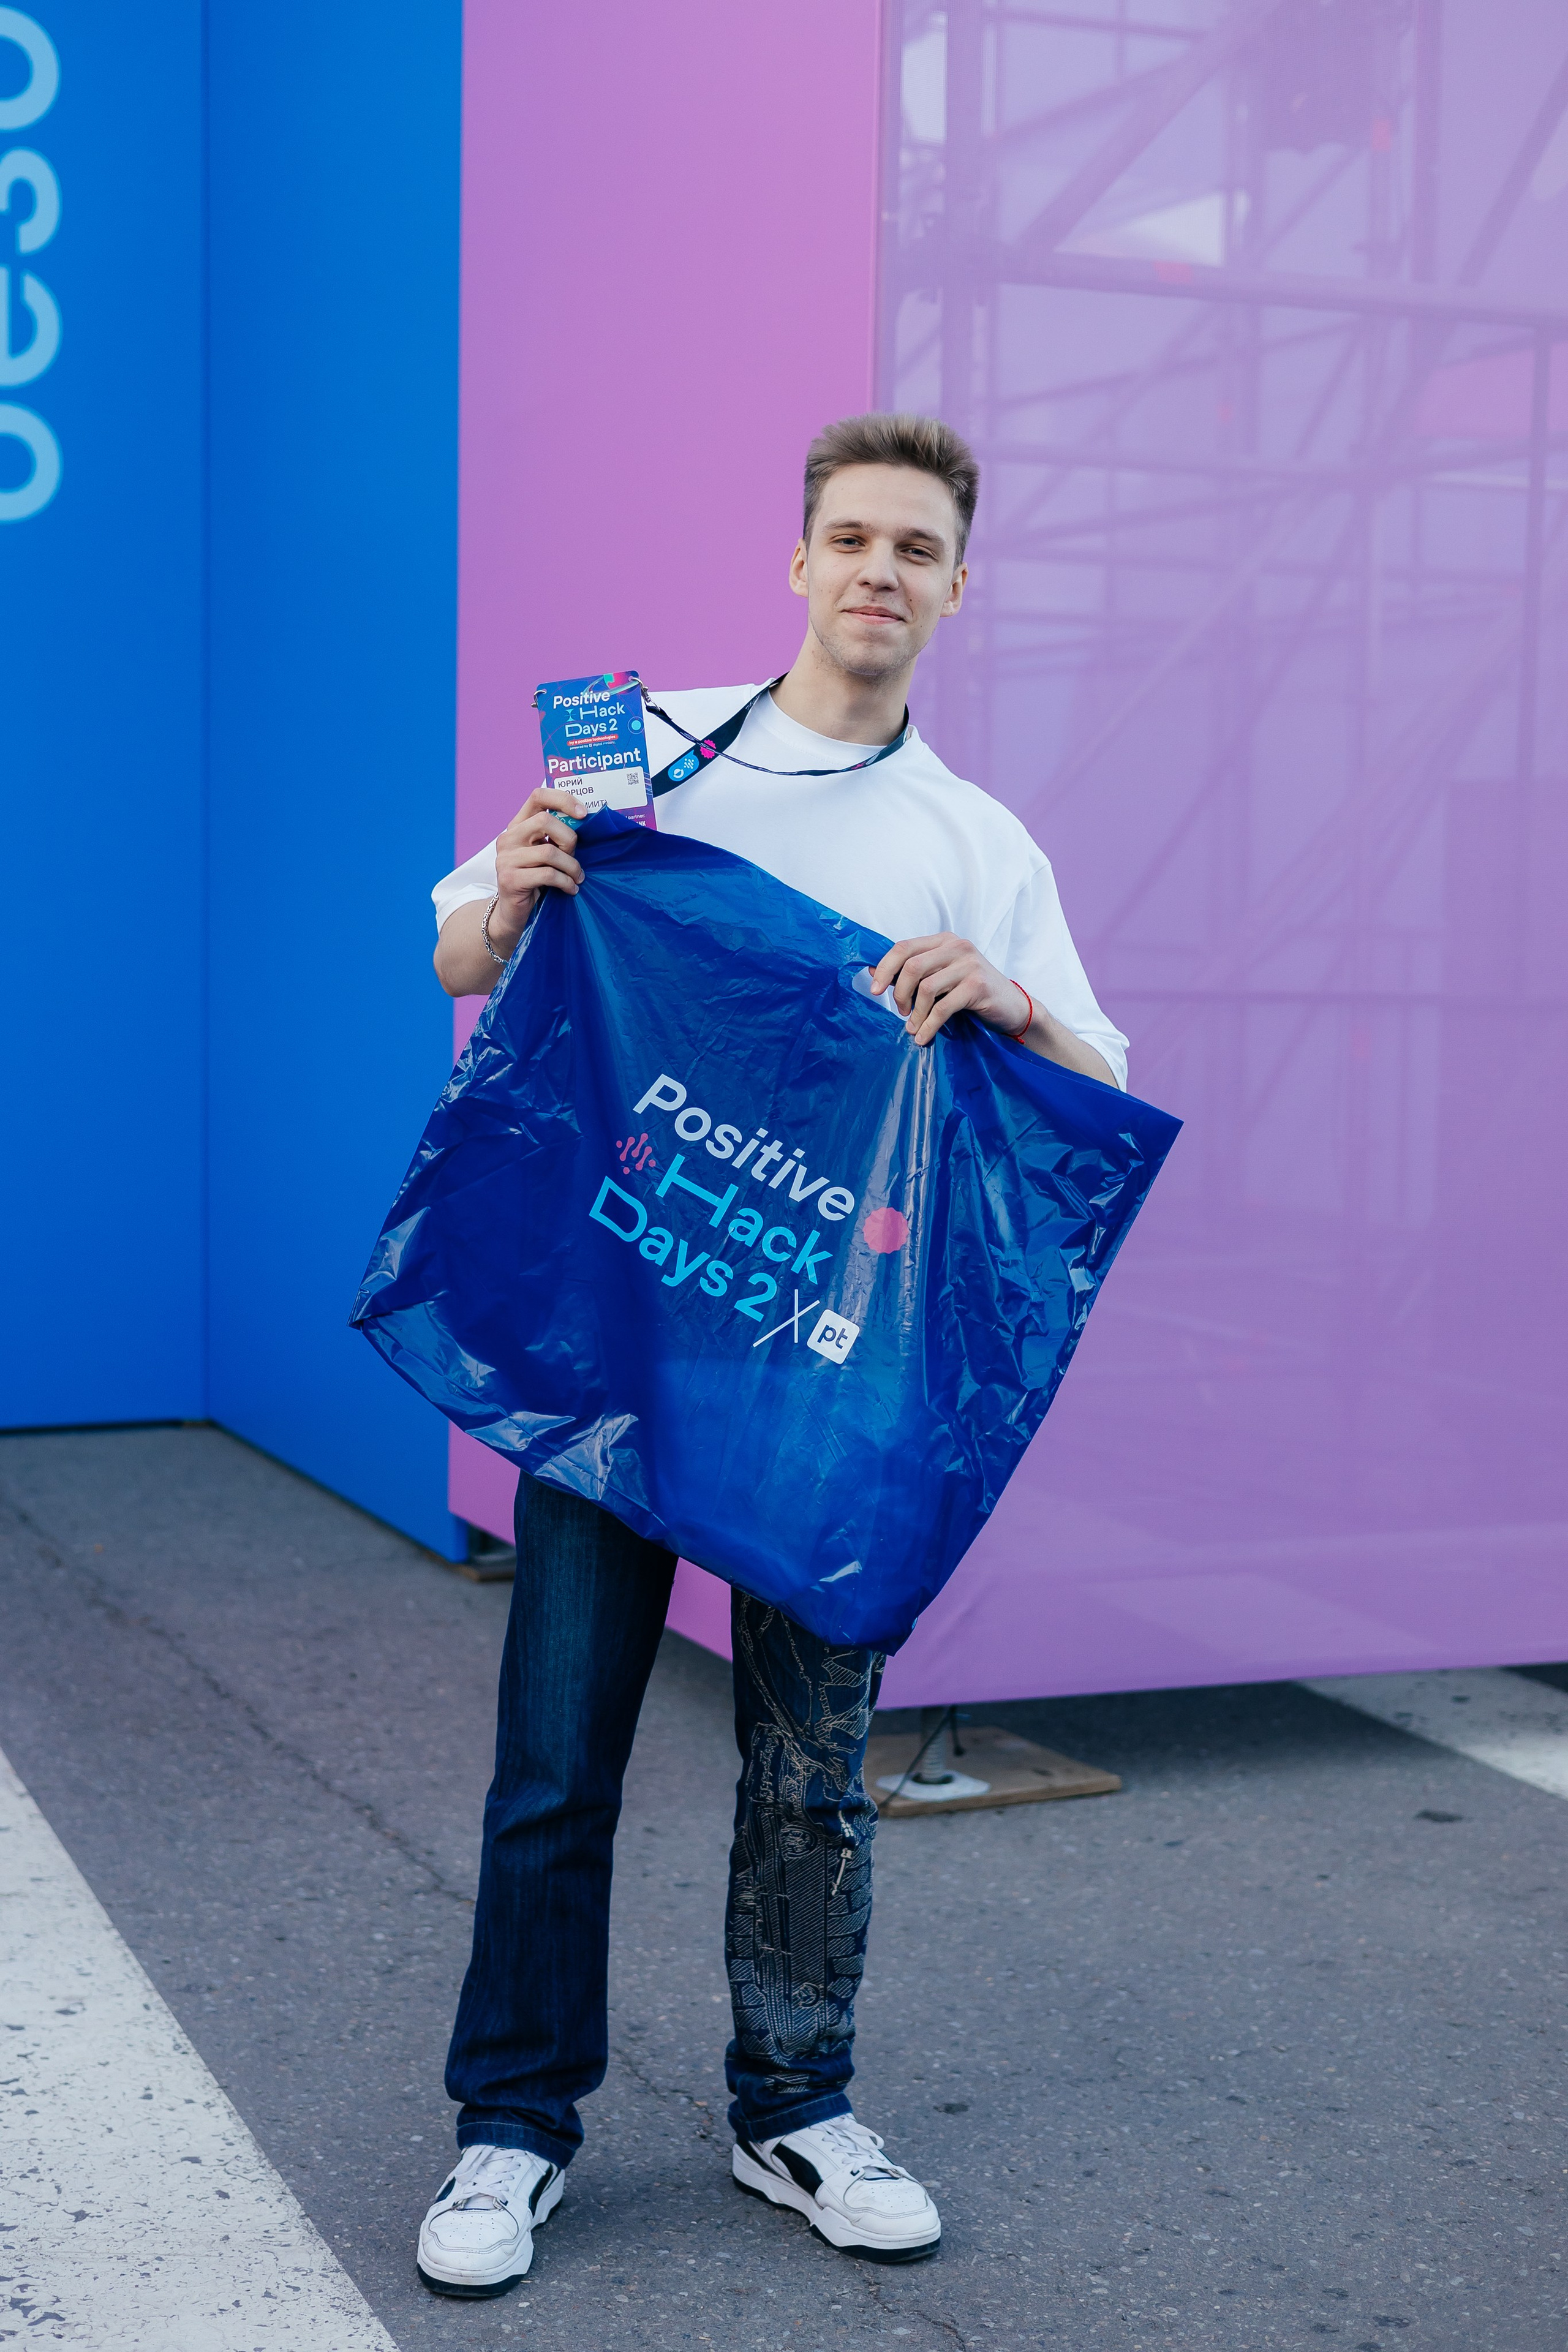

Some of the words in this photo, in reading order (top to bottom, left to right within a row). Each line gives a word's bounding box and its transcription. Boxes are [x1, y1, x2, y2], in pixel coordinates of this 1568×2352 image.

[553, 690, 611, 709] Positive
[579, 702, 625, 720] Hack
[565, 721, 608, 737] Days
[609, 718, 618, 731] 2
[548, 748, 641, 774] Participant
[558, 777, 583, 788] ЮРИЙ
[565, 786, 594, 796] ОРЦОВ
[633, 1074, 855, 1221] Positive
[655, 1153, 833, 1285] Hack
[589, 1175, 733, 1297] Days
[734, 1272, 777, 1322] 2
[817, 1324, 849, 1350] pt
